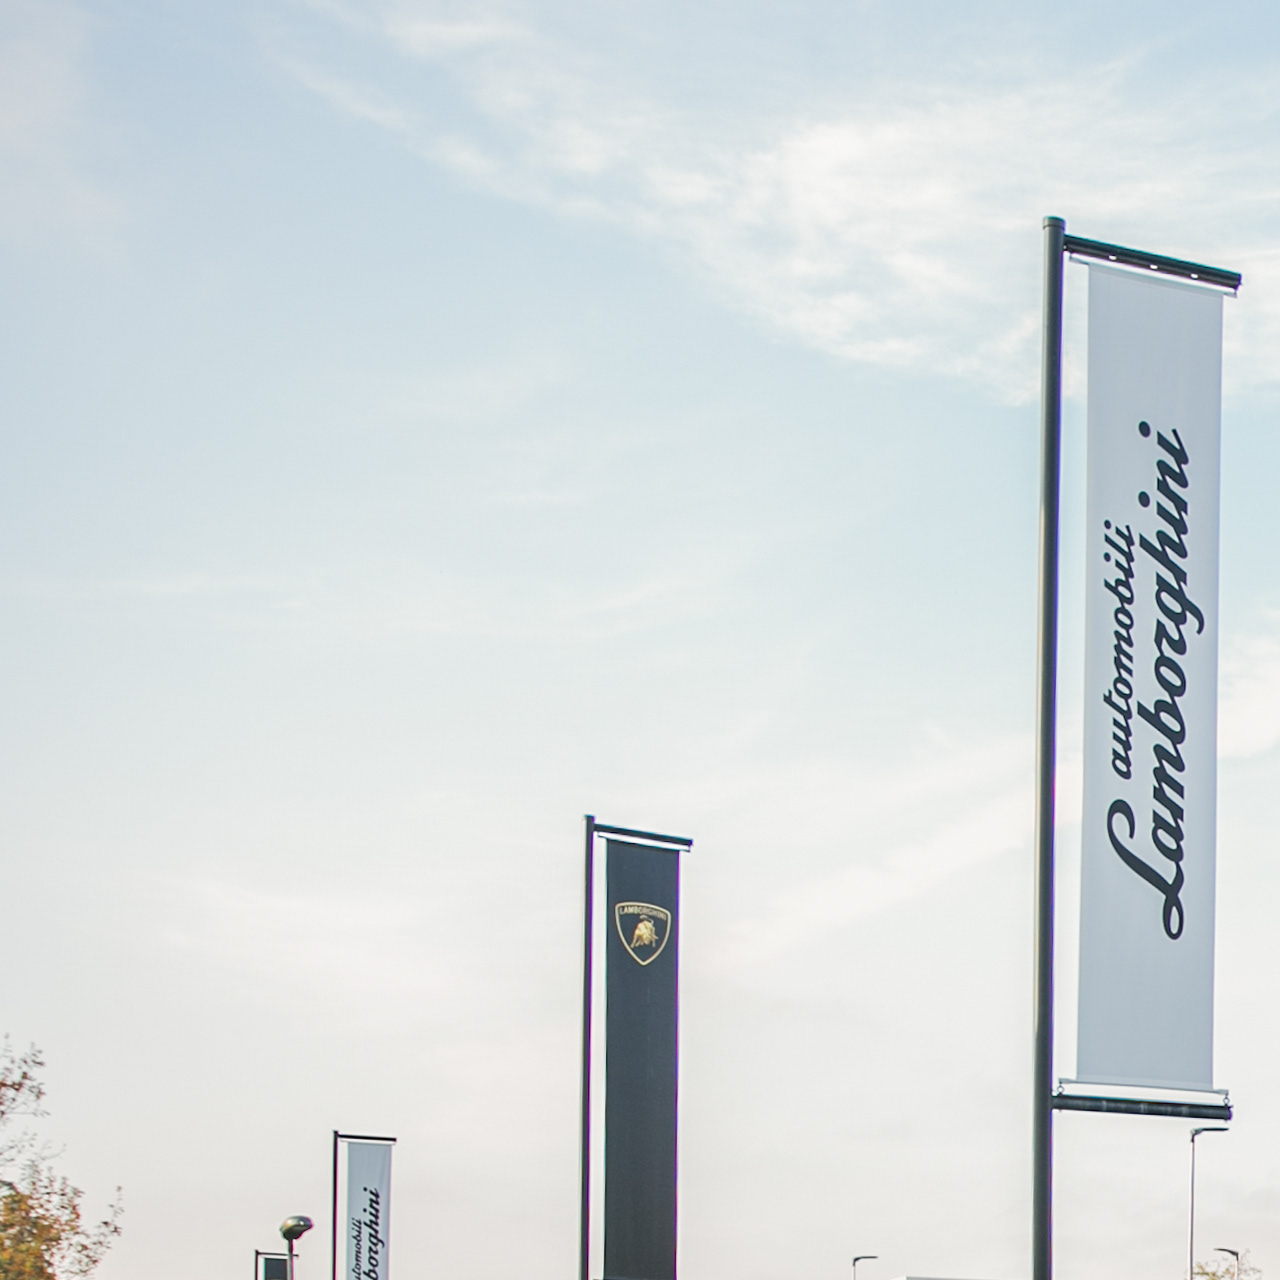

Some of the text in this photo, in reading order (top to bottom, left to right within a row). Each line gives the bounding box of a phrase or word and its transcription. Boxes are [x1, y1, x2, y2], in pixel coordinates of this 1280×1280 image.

[1102, 519, 1135, 780] automobili
[1106, 420, 1205, 941] Lamborghini
[619, 905, 667, 920] LAMBORGHINI
